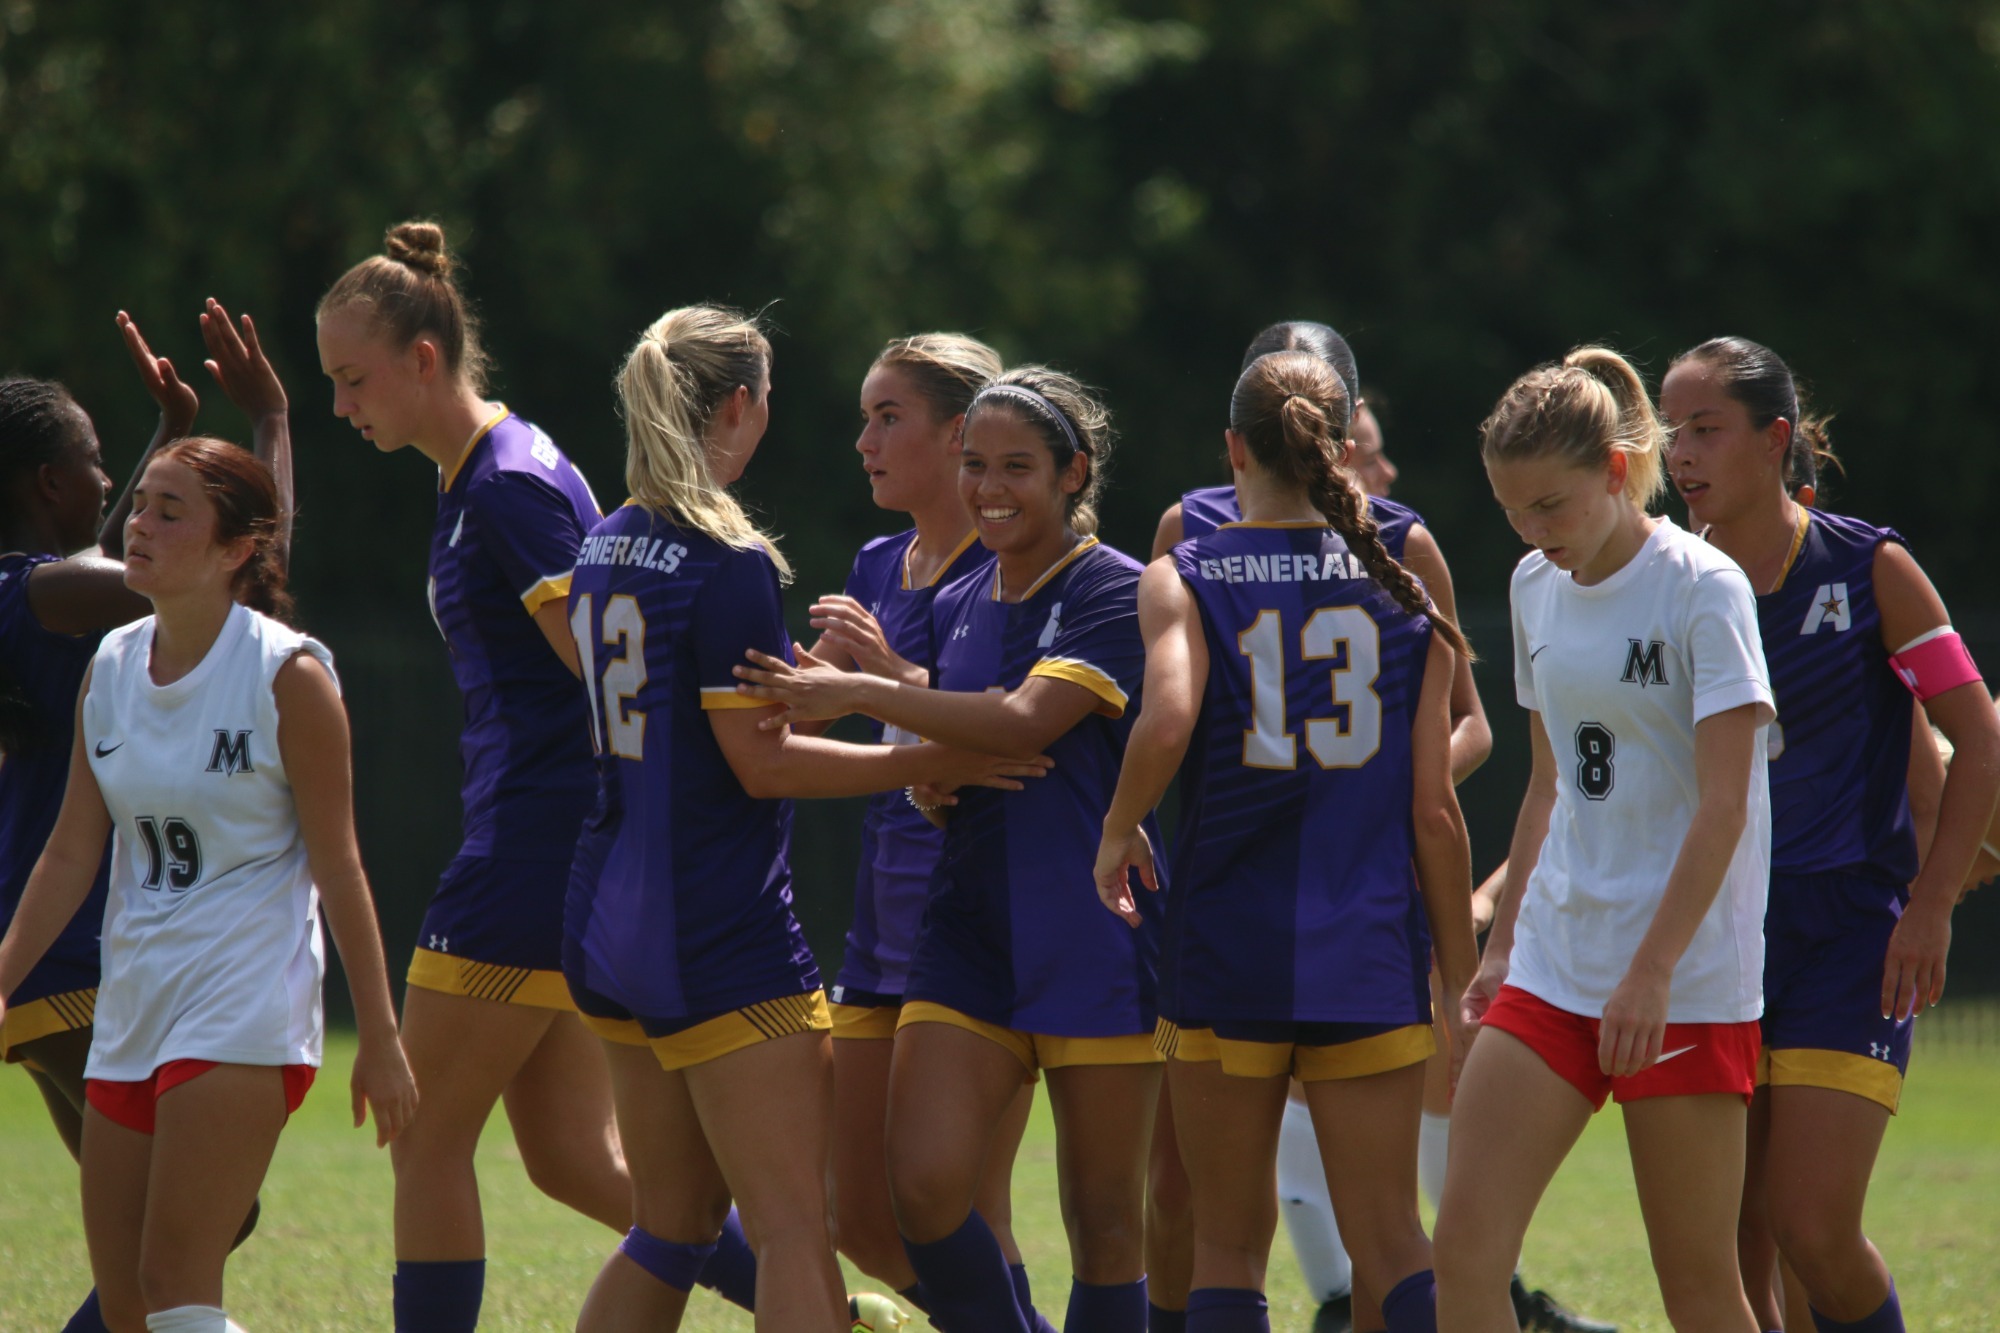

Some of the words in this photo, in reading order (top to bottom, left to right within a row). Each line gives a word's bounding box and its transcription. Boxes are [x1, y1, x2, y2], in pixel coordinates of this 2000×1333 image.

[576, 535, 688, 574] ENERALS
[1199, 553, 1369, 584] GENERAL
[570, 593, 648, 762] 12
[1237, 604, 1383, 771] 13
[1620, 638, 1670, 689] M
[205, 729, 255, 777] M
[1574, 722, 1615, 801] 8
[135, 816, 203, 892] 19
